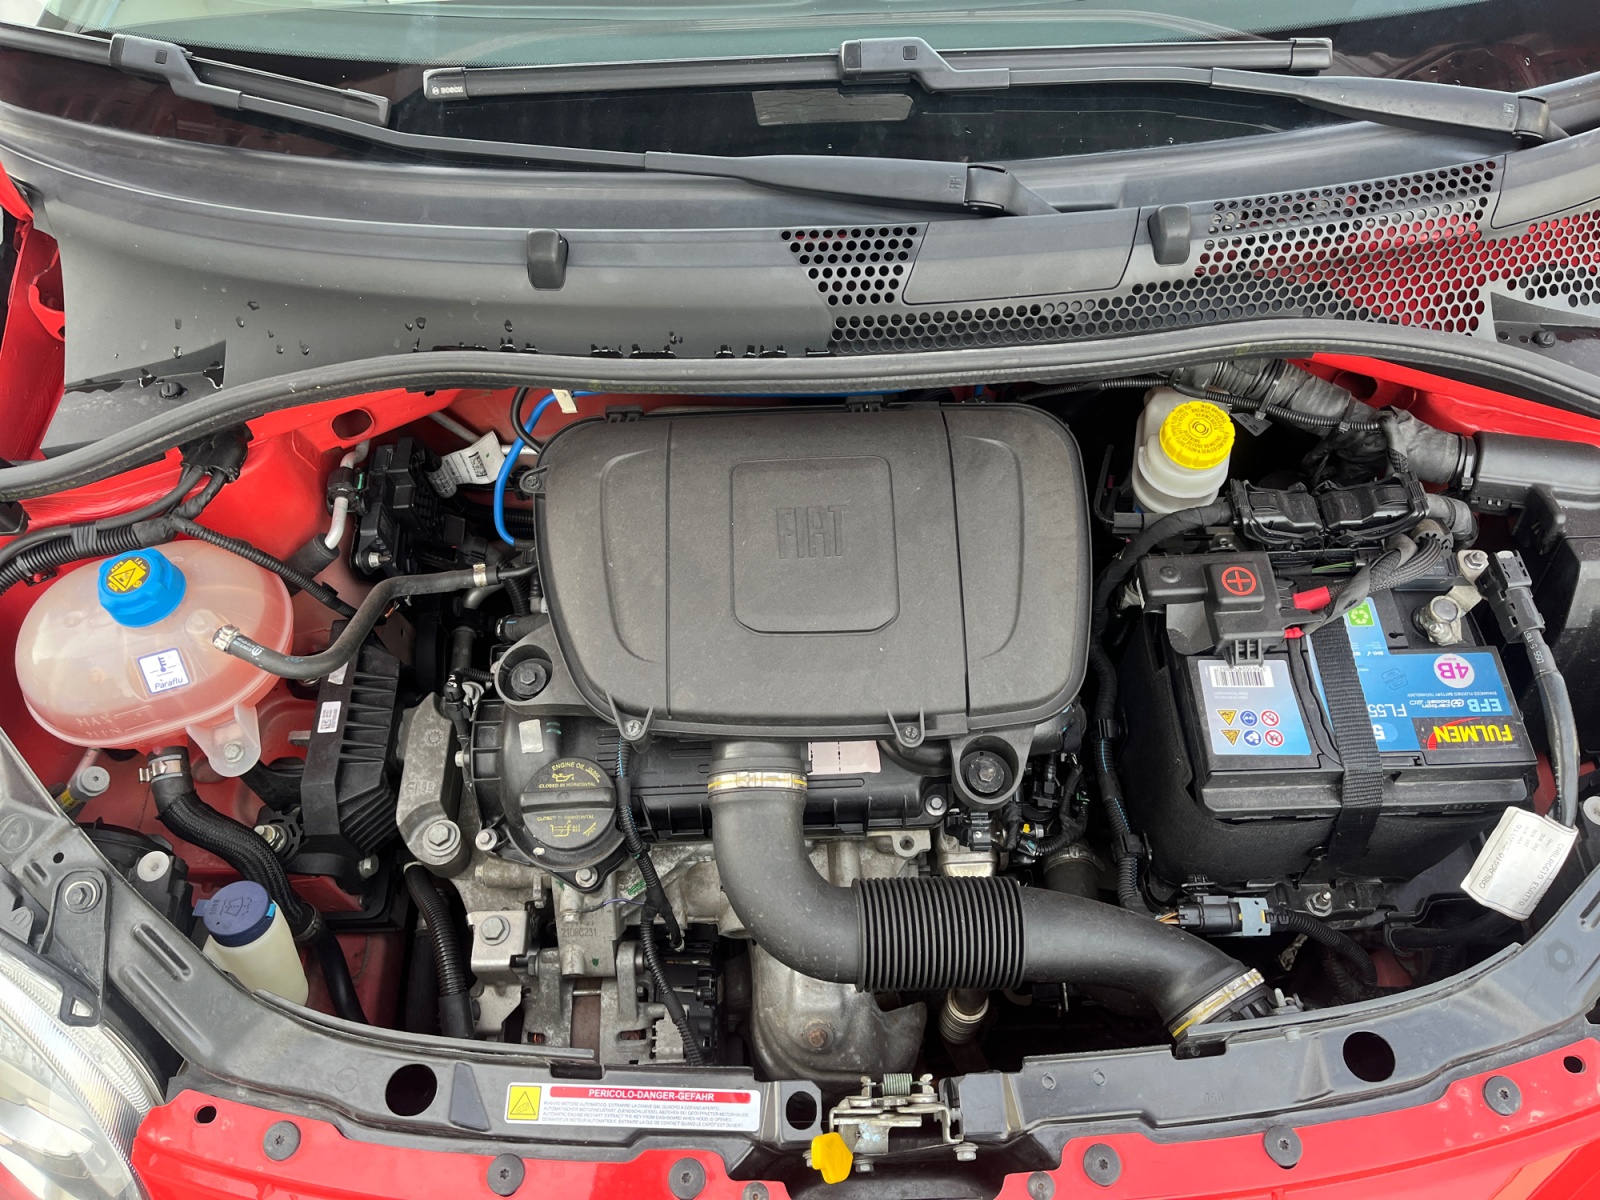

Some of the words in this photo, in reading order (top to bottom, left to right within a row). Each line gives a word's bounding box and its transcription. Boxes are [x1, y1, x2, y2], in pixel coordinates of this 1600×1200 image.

[776, 504, 846, 560] FIAT
[1436, 662, 1469, 679] 4B
[155, 678, 183, 690] Paraflu
[1467, 698, 1502, 712] EFB
[1433, 725, 1513, 743] FULMEN
[552, 762, 575, 771] ENGINE
[1479, 853, 1504, 889] CABLAGGIO
[1503, 824, 1522, 852] ESATTO
[1538, 843, 1564, 879] CABLAGGIO
[1519, 881, 1539, 906] ESATTO
[588, 1089, 714, 1101] PERICOLO-DANGER-GEFAHR
